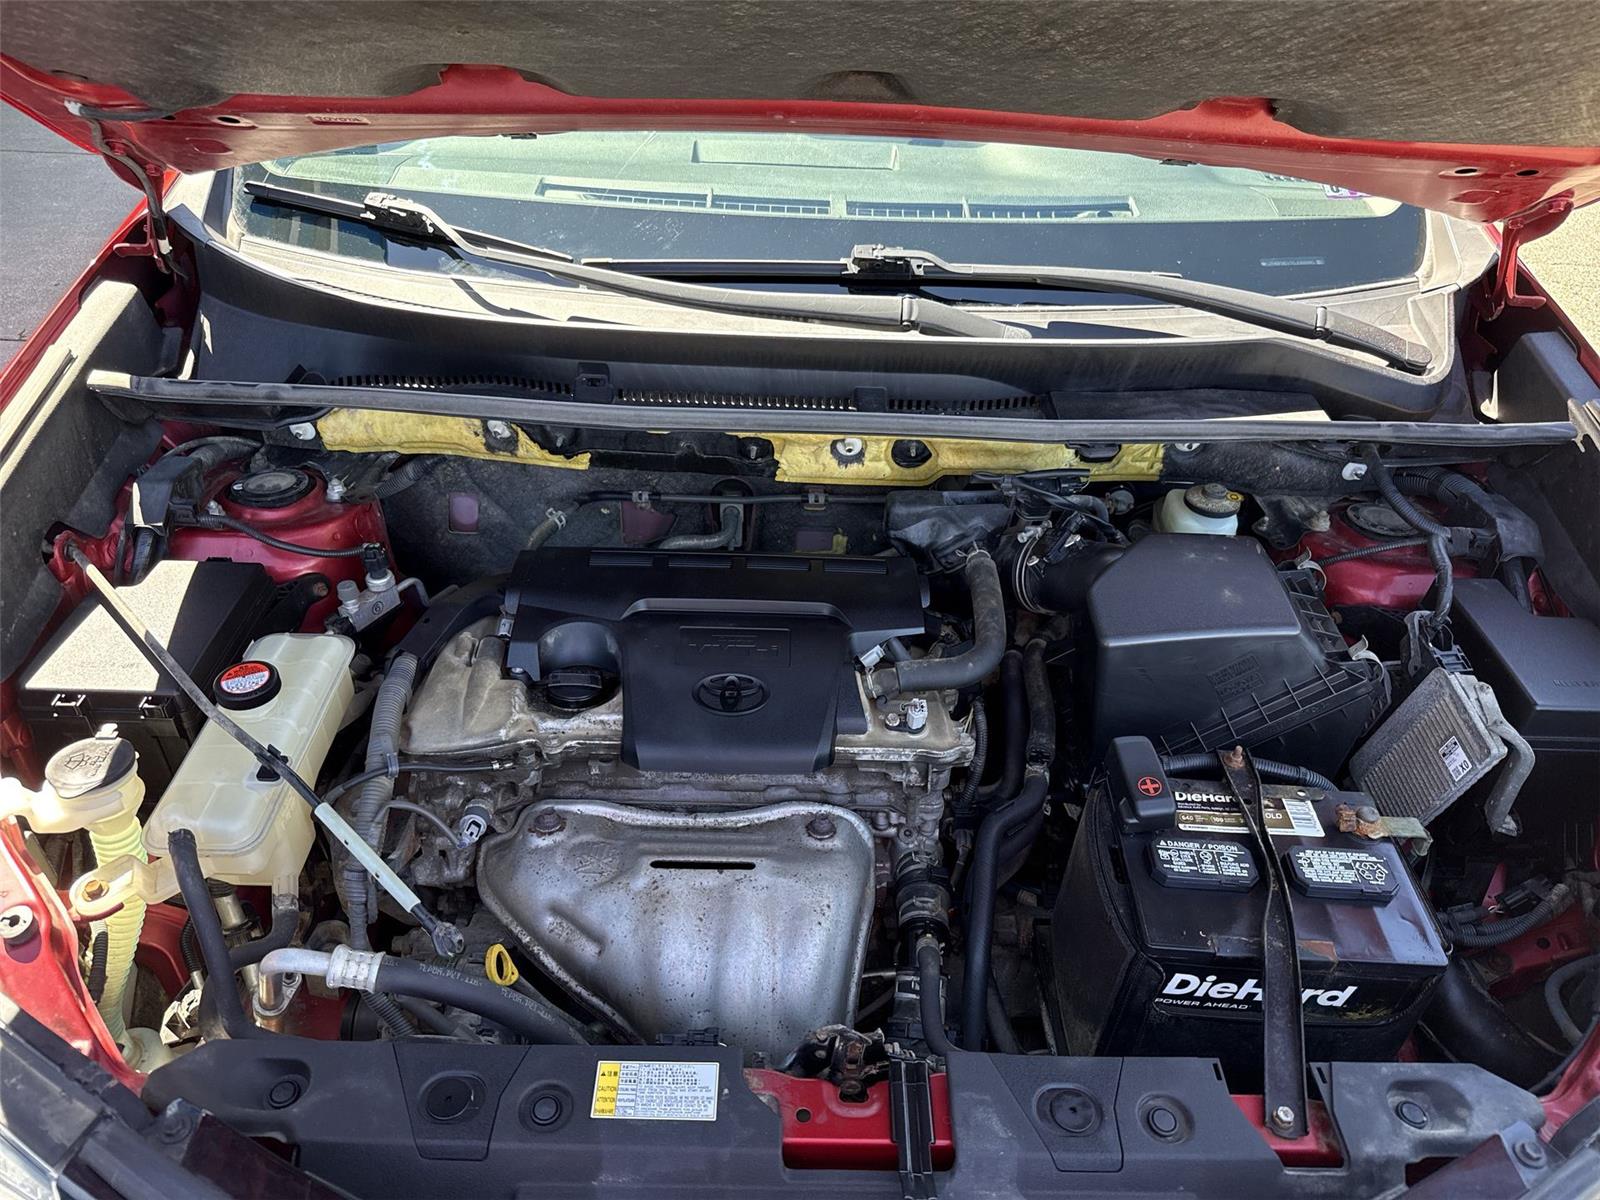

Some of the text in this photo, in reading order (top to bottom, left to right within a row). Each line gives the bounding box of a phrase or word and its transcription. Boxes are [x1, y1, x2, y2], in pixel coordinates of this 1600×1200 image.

[1175, 791, 1236, 803] DieHar
[1264, 812, 1283, 820] OLD
[1167, 840, 1200, 849] DANGER
[1208, 843, 1238, 852] POISON
[1162, 972, 1357, 1008] DieHrd
[1154, 997, 1249, 1010] POWER AHEAD
